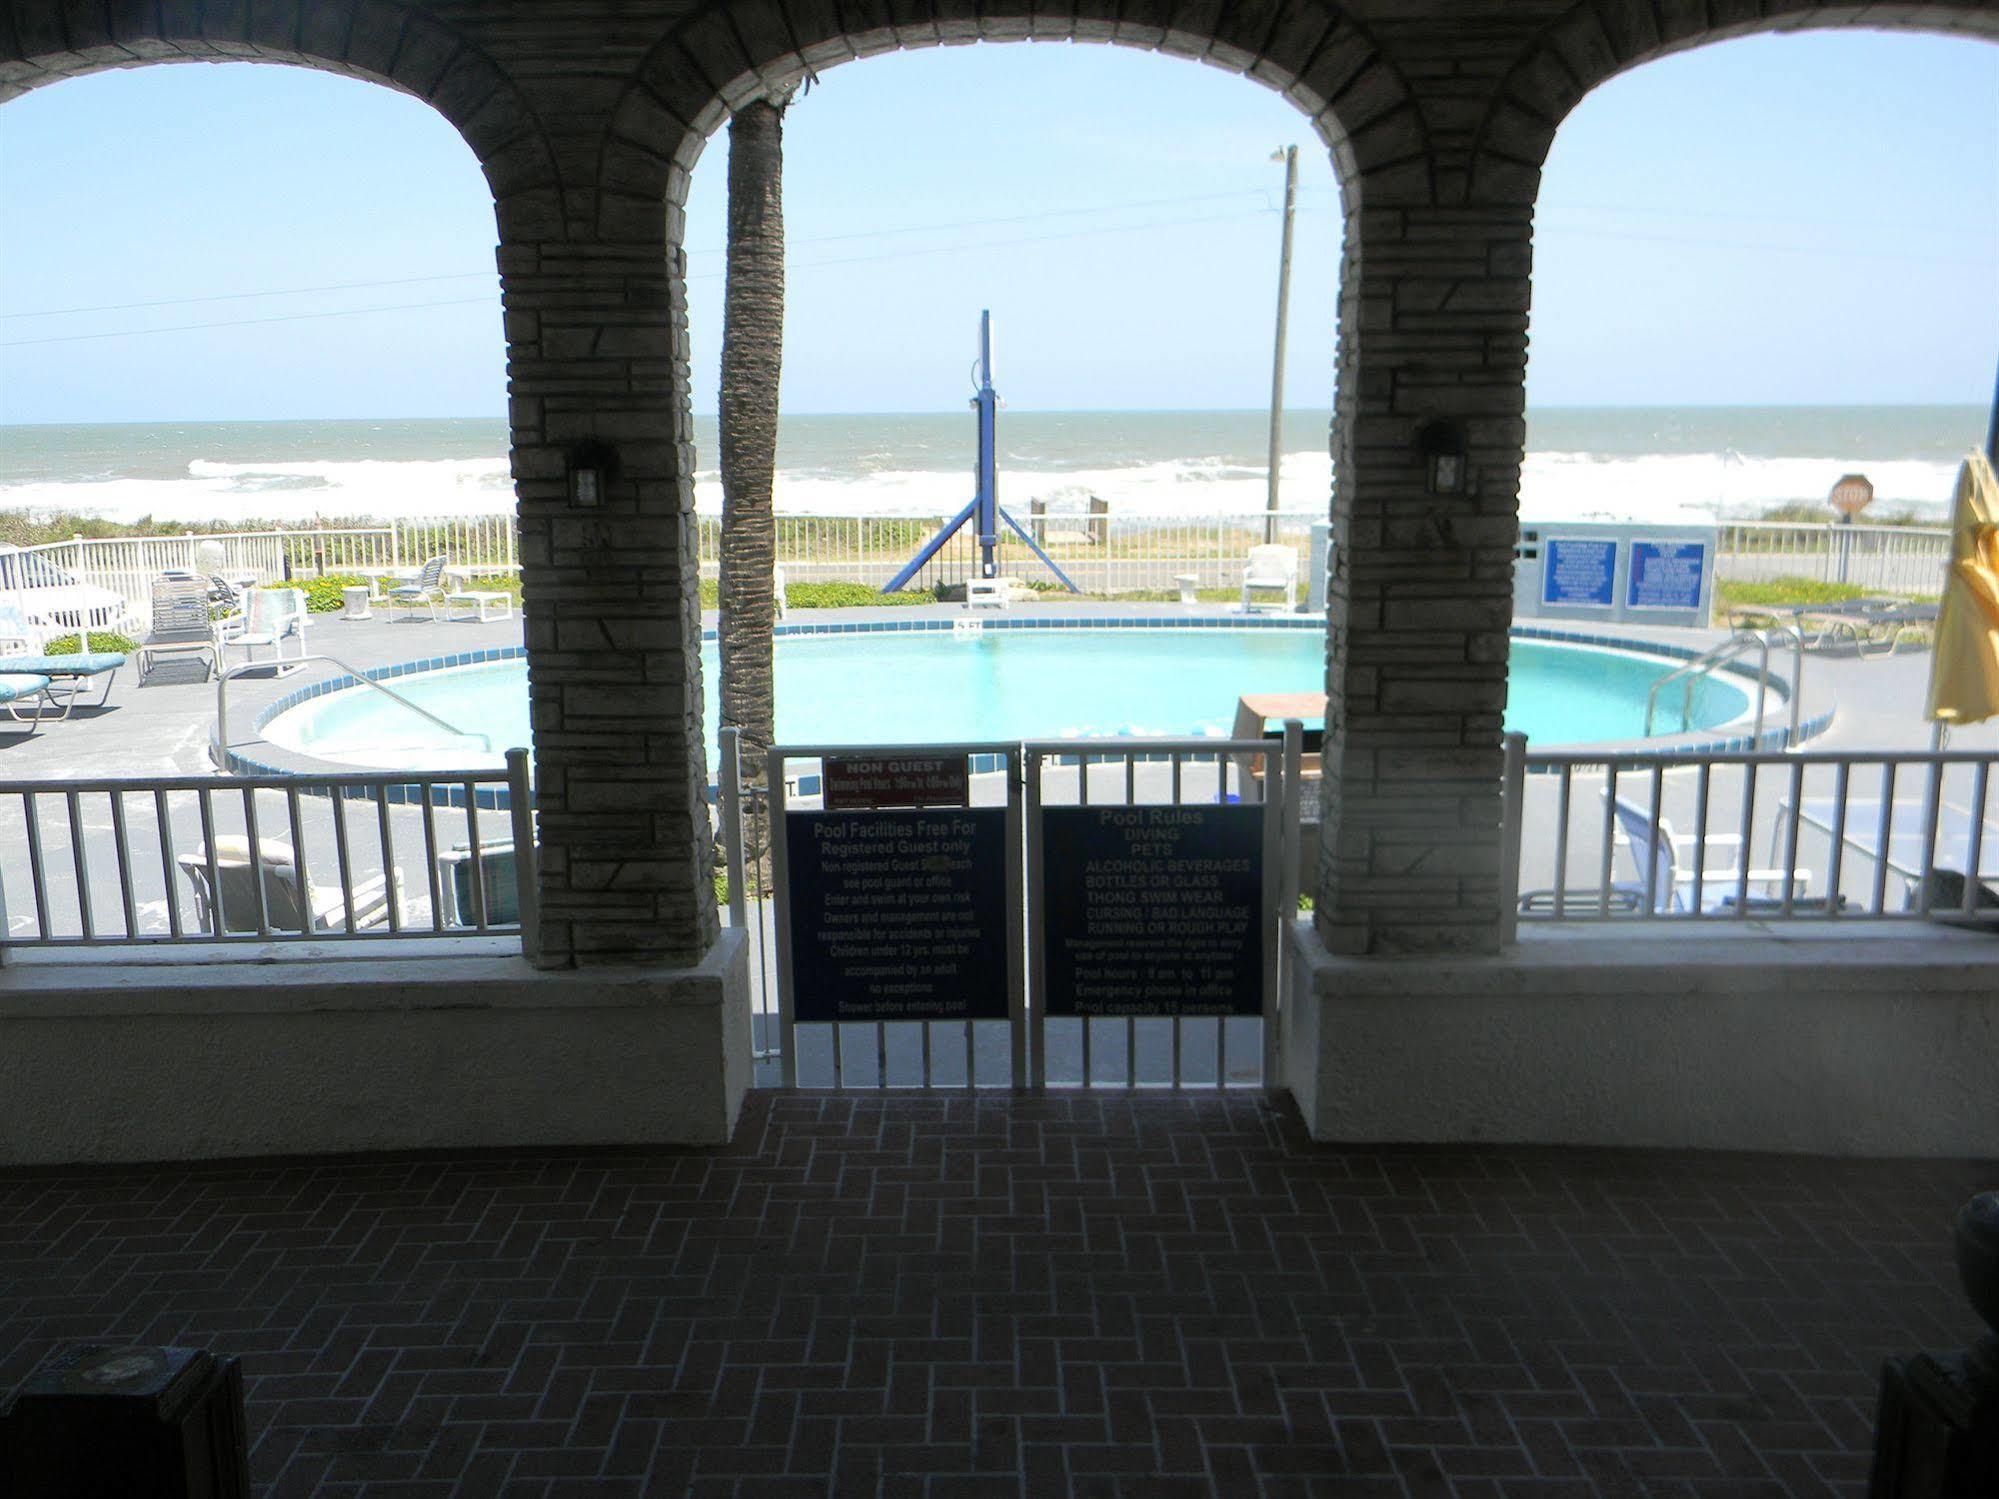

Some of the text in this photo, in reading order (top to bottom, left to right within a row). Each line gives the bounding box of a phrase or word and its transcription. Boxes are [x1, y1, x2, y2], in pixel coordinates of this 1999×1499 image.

[846, 761, 944, 774] NON GUEST
[1100, 808, 1204, 825] Pool Rules
[814, 819, 976, 838] Pool Facilities Free For
[1125, 827, 1181, 841] DIVING
[822, 839, 970, 857] Registered Guest only
[1131, 843, 1173, 856] PETS
[821, 861, 841, 872] Non
[843, 860, 889, 875] registered
[891, 859, 920, 872] Guest
[1085, 859, 1250, 872] ALCOHOLIC BEVERAGES
[843, 875, 952, 891] see pool guard or office
[1085, 874, 1218, 888] BOTTLES OR GLASS
[824, 890, 971, 907] Enter and swim at your own risk
[1087, 890, 1223, 904] THONG SWIM WEAR
[824, 912, 859, 924] Owners
[861, 911, 878, 923] and
[880, 911, 939, 925] management
[941, 911, 956, 921] are
[1086, 907, 1143, 919] CURSING
[1151, 906, 1178, 919] BAD
[1181, 906, 1249, 919] LANGUAGE
[1087, 921, 1248, 934] RUNNING OR ROUGH PLAY
[817, 928, 871, 943] responsible
[873, 928, 887, 940] for
[889, 927, 932, 940] accidents
[830, 945, 869, 957] Children
[871, 944, 897, 956] under
[901, 944, 912, 955] 12
[932, 943, 955, 954] must
[957, 943, 969, 954] be
[845, 962, 957, 979] accompanied by an adult
[1075, 967, 1102, 979] Pool
[1104, 967, 1137, 979] hours
[1182, 967, 1193, 979] to
[869, 983, 933, 996] no exceptions
[1075, 984, 1232, 998] Emergency phone in office
[838, 998, 966, 1014] Shower before entering pool
[1074, 1001, 1103, 1013] Pool
[1106, 1001, 1159, 1014] capacity
[1182, 1002, 1234, 1014] persons
